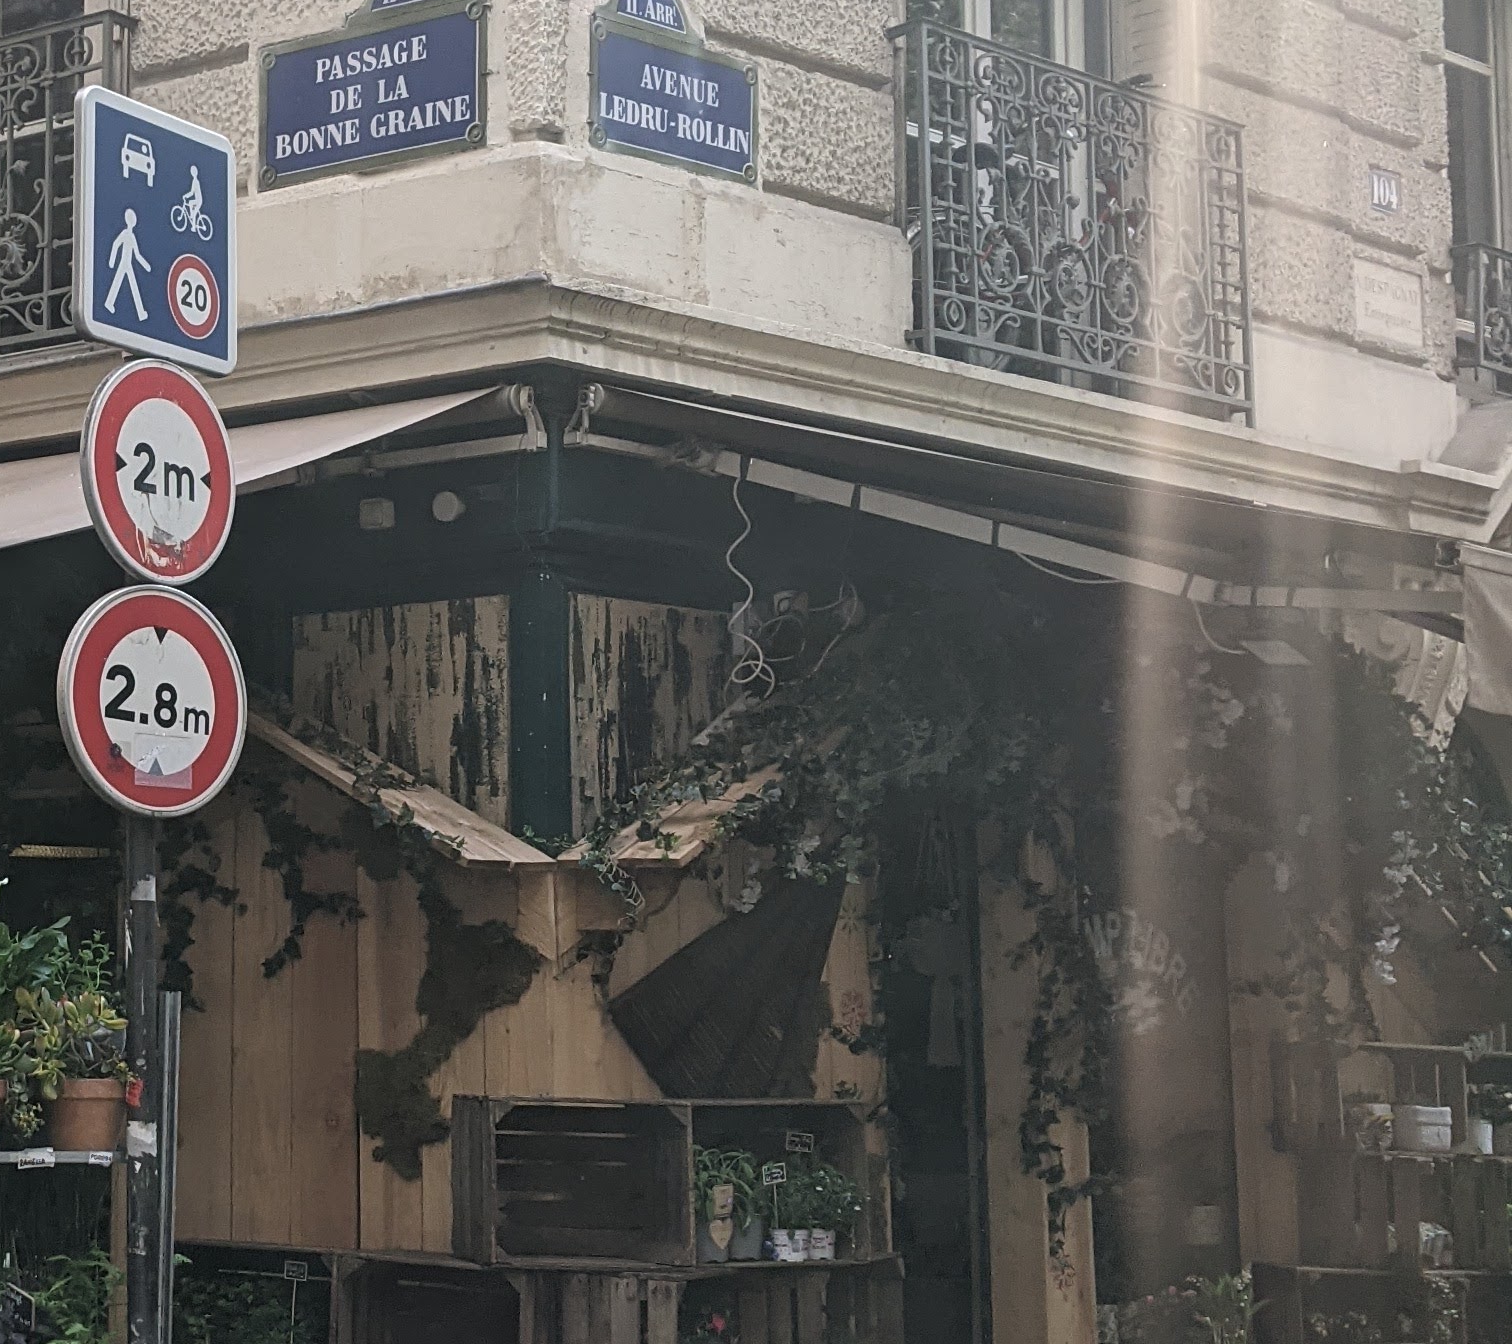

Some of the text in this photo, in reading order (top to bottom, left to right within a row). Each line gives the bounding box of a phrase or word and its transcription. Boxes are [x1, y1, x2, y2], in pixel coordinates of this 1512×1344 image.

[315, 35, 427, 83] PASSAGE
[330, 74, 409, 114] DE LA
[640, 63, 720, 108] AVENUE
[275, 94, 471, 159] BONNE GRAINE
[599, 91, 750, 155] LEDRU-ROLLIN
[1372, 174, 1398, 209] 104
[180, 279, 208, 312] 20
